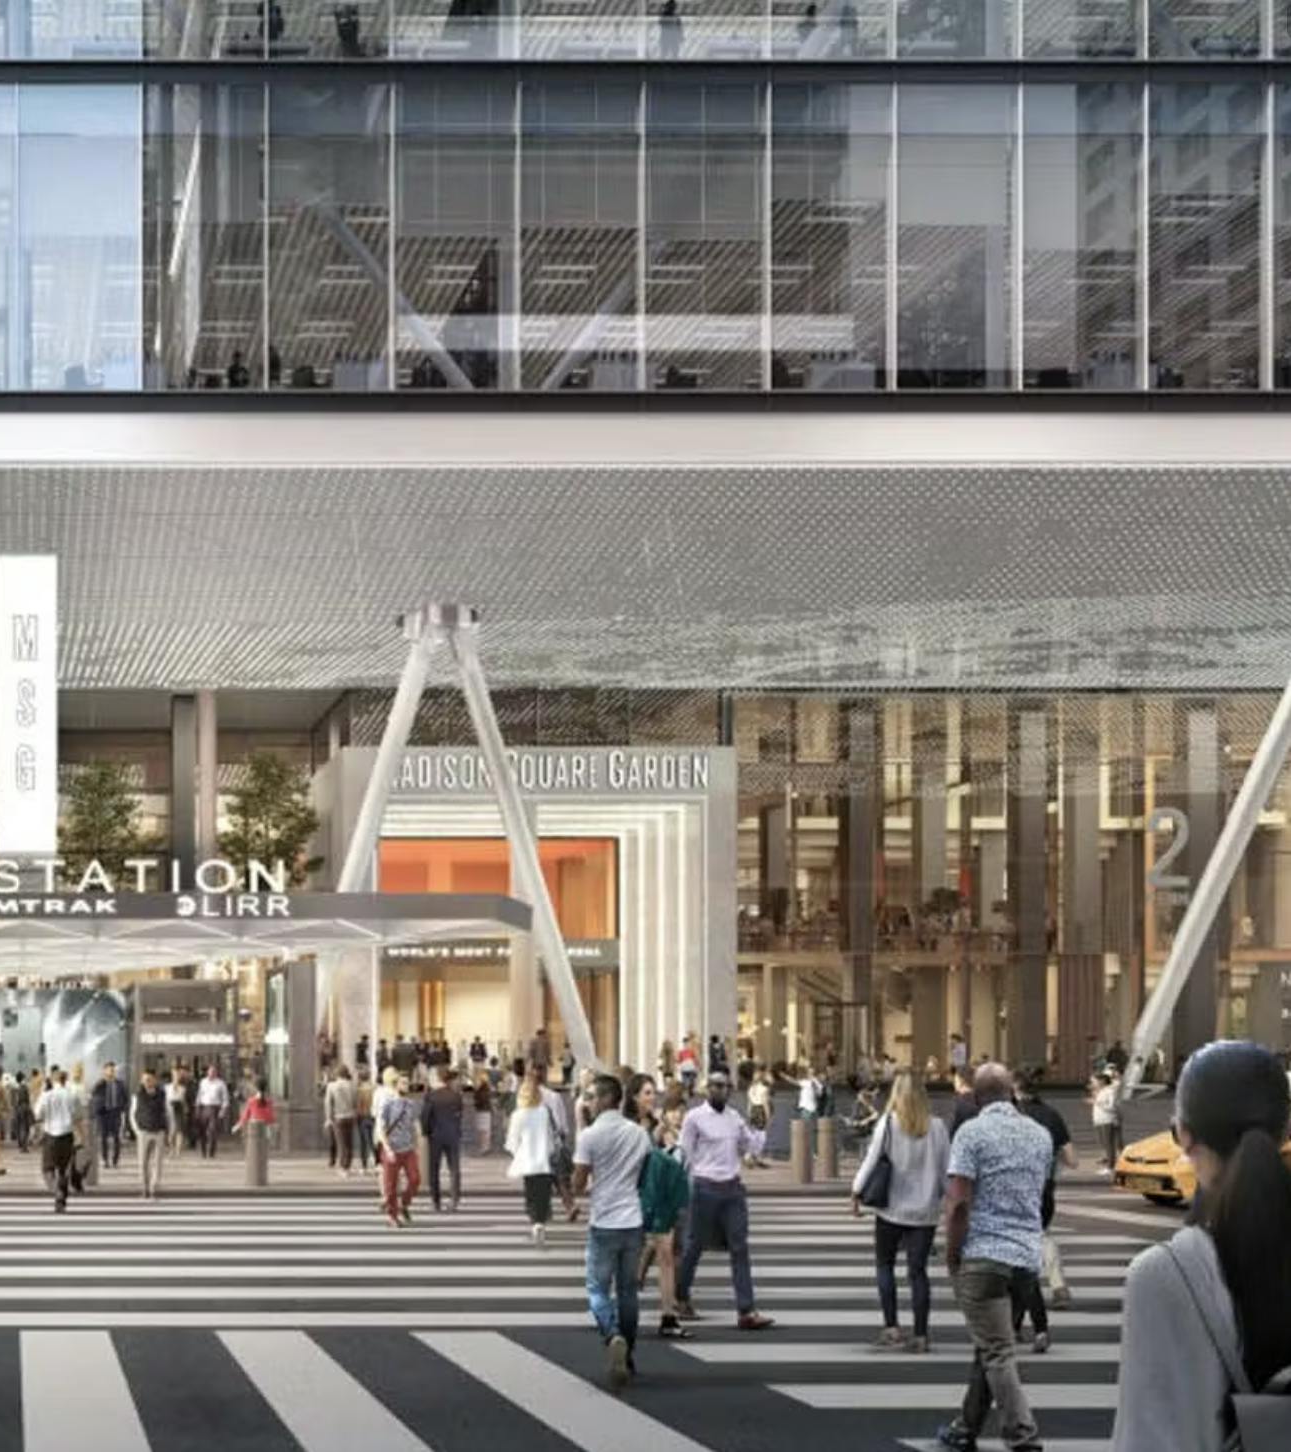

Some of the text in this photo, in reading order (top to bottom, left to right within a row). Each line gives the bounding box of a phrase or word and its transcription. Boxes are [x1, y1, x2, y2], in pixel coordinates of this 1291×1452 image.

[12, 614, 38, 791] MSG
[392, 753, 494, 789] ADISON
[609, 749, 709, 788] GARDEN
[1149, 807, 1189, 888] 2
[202, 895, 291, 917] LIRR
